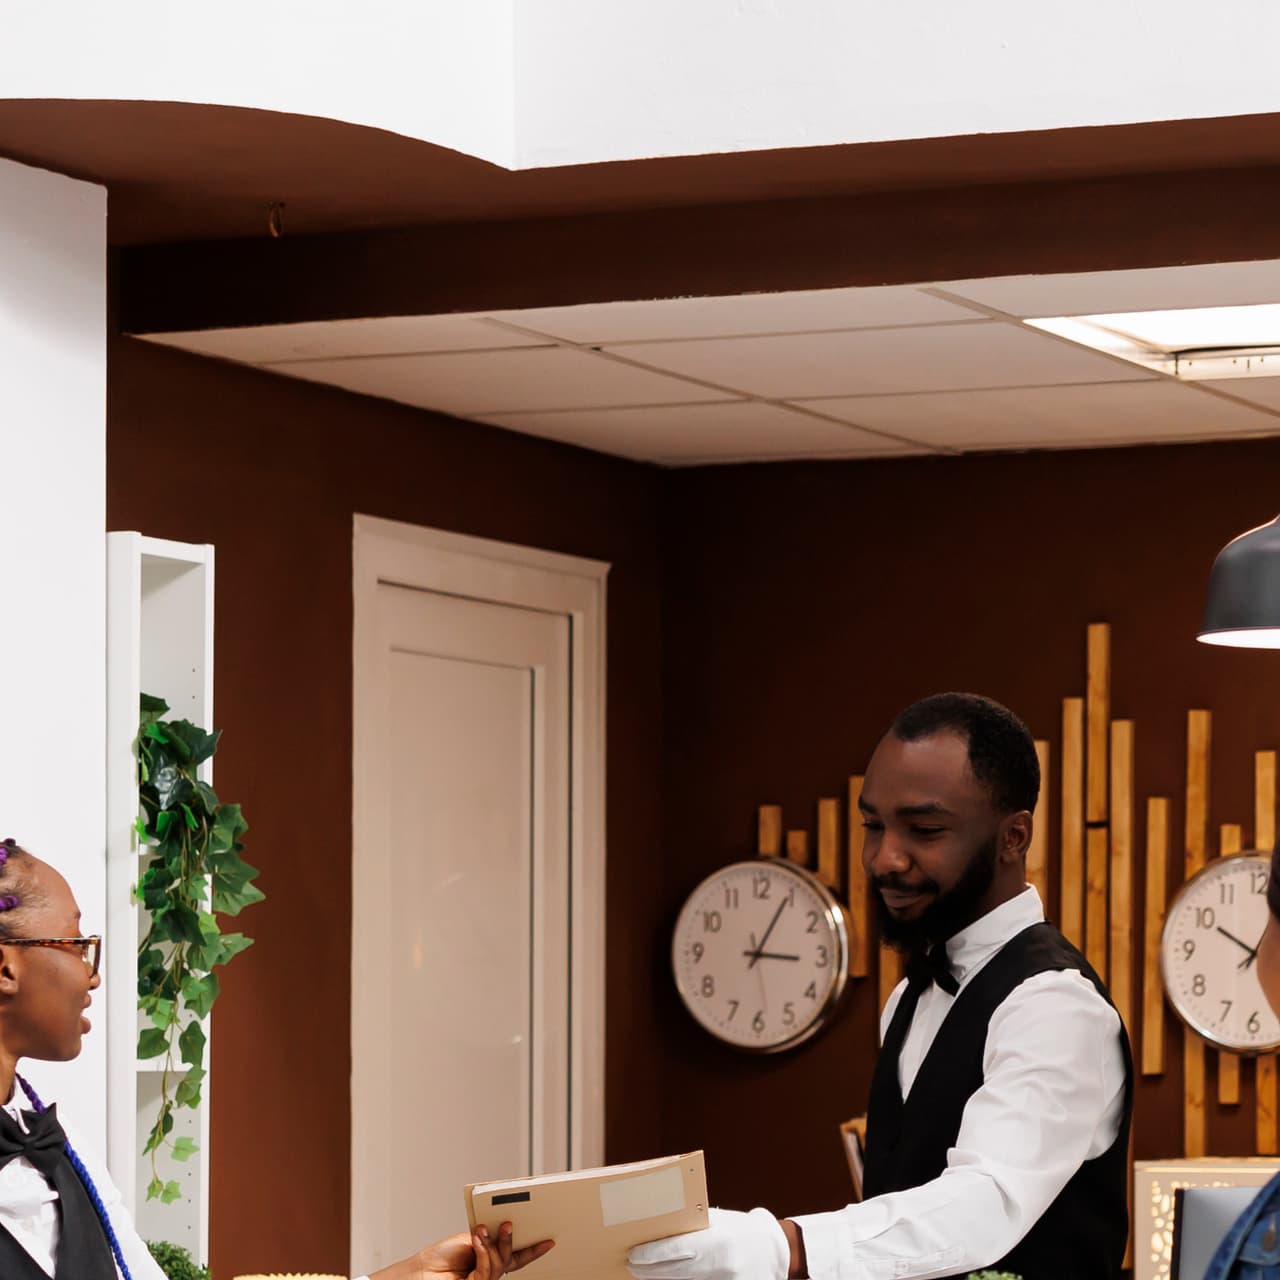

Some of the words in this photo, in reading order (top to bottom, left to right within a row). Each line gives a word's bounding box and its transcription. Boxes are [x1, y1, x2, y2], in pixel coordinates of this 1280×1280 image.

[752, 877, 770, 900] 12
[1220, 883, 1234, 904] 11
[1249, 872, 1269, 895] 12
[724, 887, 739, 909] 11
[703, 911, 721, 933] 10
[806, 911, 819, 933] 2
[1194, 907, 1215, 929] 10
[692, 942, 705, 964] 9
[816, 946, 829, 968] 3
[1182, 940, 1196, 961] 9
[701, 975, 715, 998] 8
[804, 980, 817, 1001] 4
[1192, 974, 1206, 997] 8
[728, 1000, 739, 1022] 7
[751, 1011, 765, 1033] 6
[782, 1002, 795, 1025] 5
[1220, 1000, 1233, 1022] 7
[1246, 1011, 1260, 1034] 6
